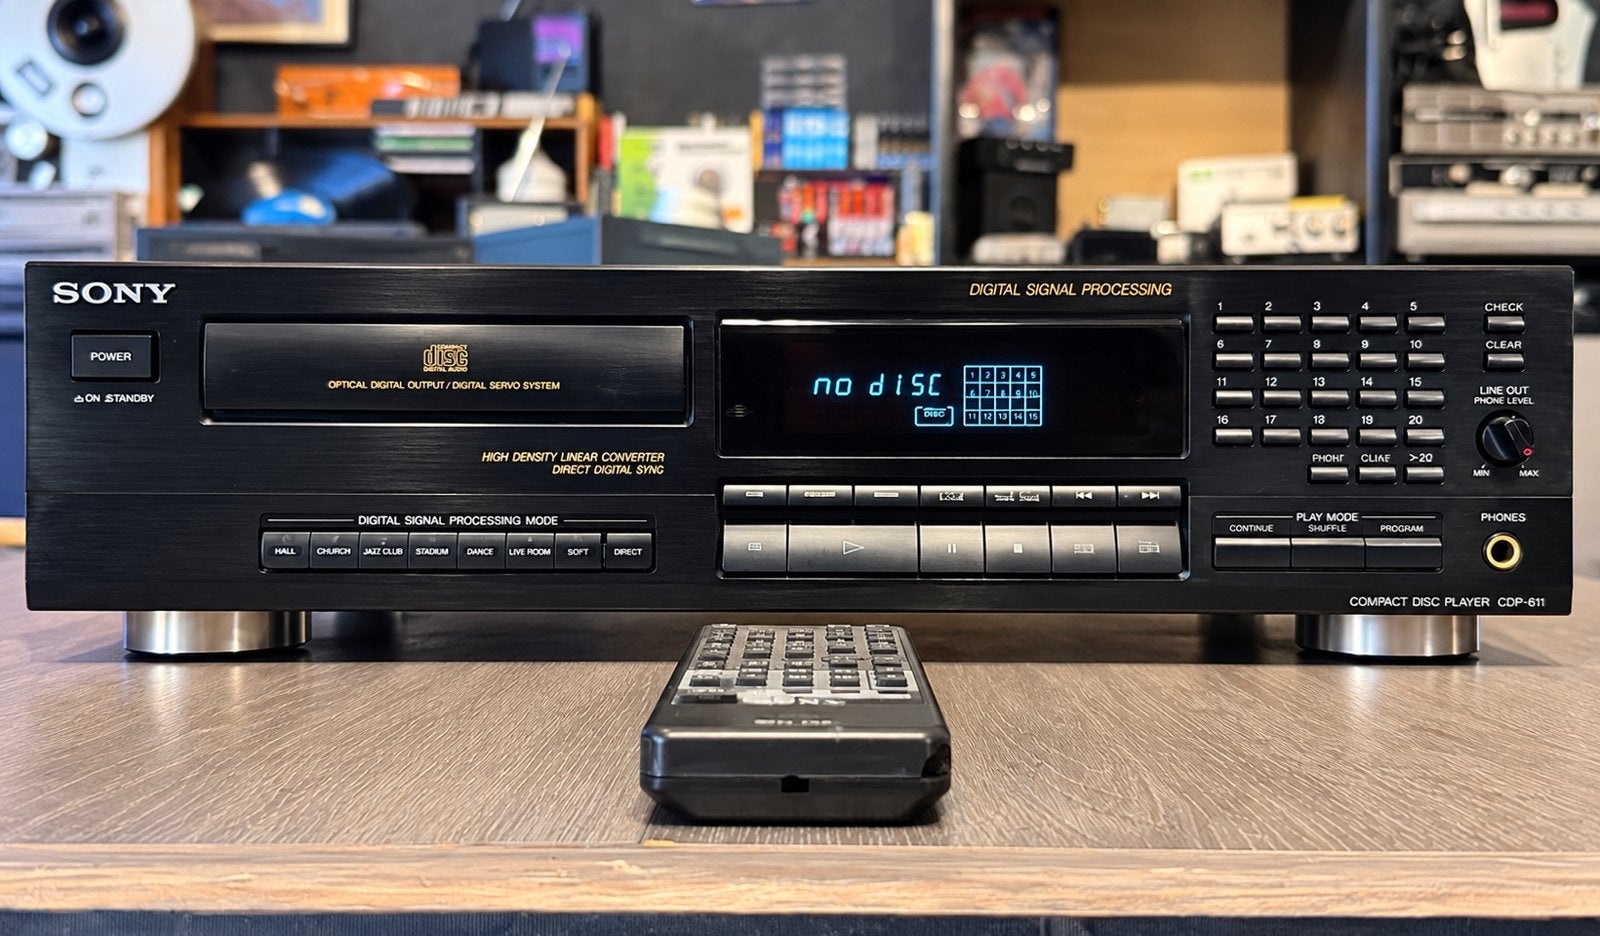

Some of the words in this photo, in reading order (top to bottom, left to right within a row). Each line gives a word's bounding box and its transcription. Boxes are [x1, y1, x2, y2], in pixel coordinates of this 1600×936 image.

[53, 282, 176, 304] SONY
[969, 282, 1020, 296] DIGITAL
[1025, 282, 1076, 296] SIGNAL
[1081, 282, 1172, 296] PROCESSING
[1217, 302, 1223, 311] 1
[1265, 302, 1272, 311] 2
[1313, 302, 1321, 311] 3
[1361, 302, 1369, 311] 4
[1409, 302, 1417, 311] 5
[1484, 303, 1524, 311] CHECK
[1216, 340, 1224, 349] 6
[1265, 340, 1272, 349] 7
[1313, 340, 1321, 349] 8
[1361, 340, 1369, 349] 9
[1409, 340, 1422, 349] 10
[1485, 340, 1522, 349] CLEAR
[90, 352, 132, 361] POWER
[328, 380, 368, 390] OPTICAL
[370, 380, 405, 390] DIGITAL
[407, 380, 445, 390] OUTPUT
[452, 380, 487, 390] DIGITAL
[489, 380, 520, 390] SERVO
[522, 380, 560, 390] SYSTEM
[813, 377, 852, 396] no
[1217, 377, 1226, 387] 11
[1265, 377, 1277, 387] 12
[1313, 377, 1325, 387] 13
[1361, 377, 1373, 387] 14
[1409, 377, 1422, 387] 15
[1480, 386, 1503, 395] LINE
[1506, 386, 1529, 395] OUT
[85, 394, 100, 403] ON
[104, 394, 155, 403] STANDBY
[1474, 397, 1504, 405] PHONE
[1507, 397, 1534, 405] LEVEL
[1217, 415, 1229, 425] 16
[1265, 415, 1277, 425] 17
[1408, 415, 1423, 425] 20
[482, 452, 509, 462] HIGH
[512, 452, 557, 462] DENSITY
[560, 452, 598, 462] LINEAR
[601, 452, 665, 462] CONVERTER
[552, 465, 591, 475] DIRECT
[594, 465, 632, 475] DIGITAL
[635, 465, 664, 475] SYNC
[1473, 469, 1490, 477] MIN
[358, 515, 400, 525] DIGITAL
[404, 515, 445, 525] SIGNAL
[449, 515, 521, 526] PROCESSING
[525, 516, 558, 526] MODE
[1296, 513, 1322, 522] PLAY
[1326, 513, 1359, 522] MODE
[1481, 513, 1526, 522] PHONES
[1229, 524, 1274, 532] CONTINUE
[1308, 524, 1347, 533] SHUFFLE
[466, 548, 494, 556] DANCE
[509, 548, 525, 556] LIVE
[527, 548, 551, 556] ROOM
[567, 548, 589, 556] SOFT
[613, 548, 643, 556] DIRECT
[1350, 597, 1408, 607] COMPACT
[1412, 597, 1440, 607] DISC
[1445, 597, 1490, 607] PLAYER
[1497, 597, 1546, 607] CDP-611
